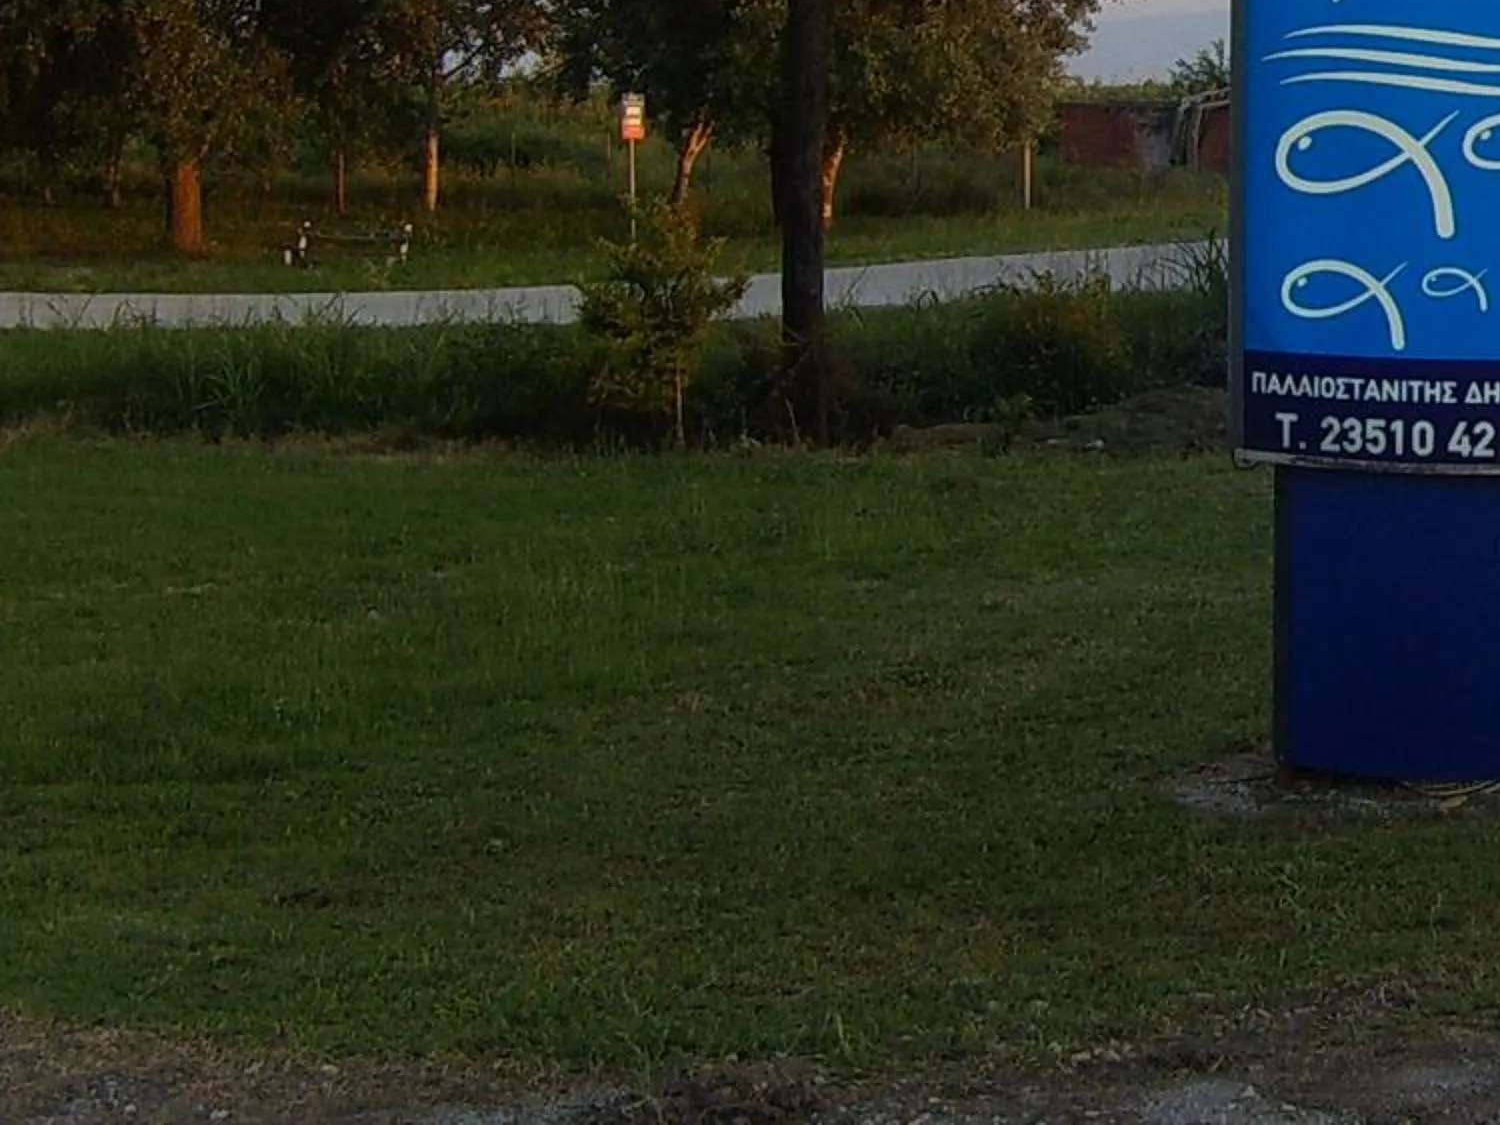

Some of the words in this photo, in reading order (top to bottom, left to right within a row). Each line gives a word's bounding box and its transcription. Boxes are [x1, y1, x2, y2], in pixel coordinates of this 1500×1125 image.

[1251, 371, 1458, 405] ΠΑΛΑΙΟΣΤΑΝΙΤΗΣ
[1320, 416, 1435, 456] 23510
[1448, 420, 1495, 458] 42
